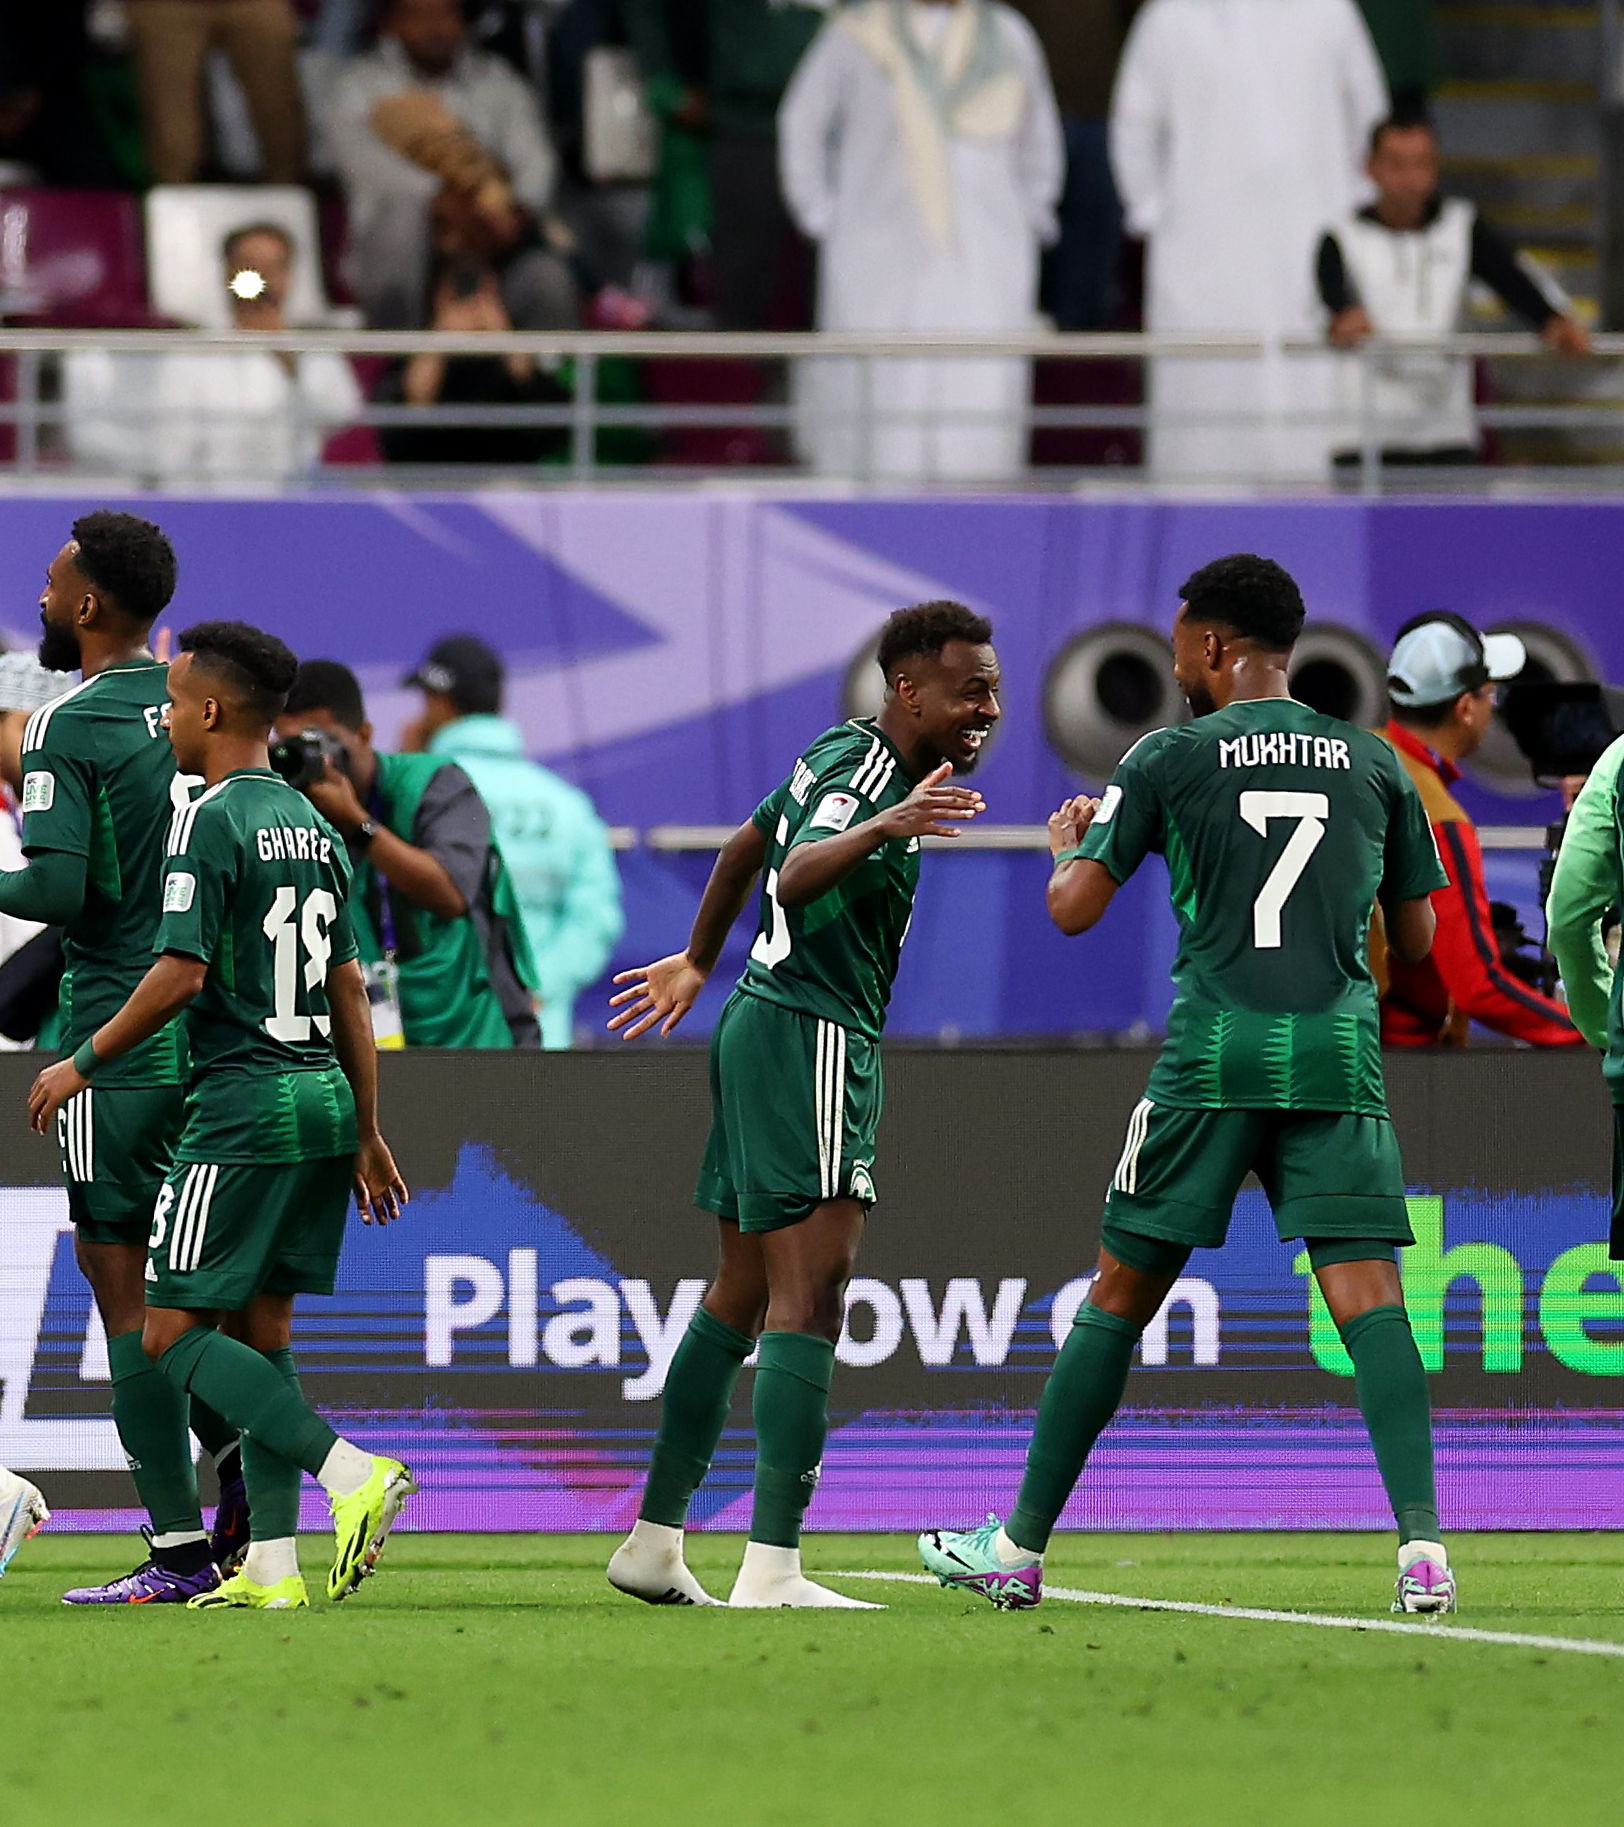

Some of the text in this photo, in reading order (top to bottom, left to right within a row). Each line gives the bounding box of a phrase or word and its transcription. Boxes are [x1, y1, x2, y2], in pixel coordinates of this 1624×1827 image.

[1218, 732, 1351, 770] MUKHTAR
[1239, 790, 1329, 948] 7
[423, 1247, 706, 1401] Play
[742, 1277, 1028, 1368] ow
